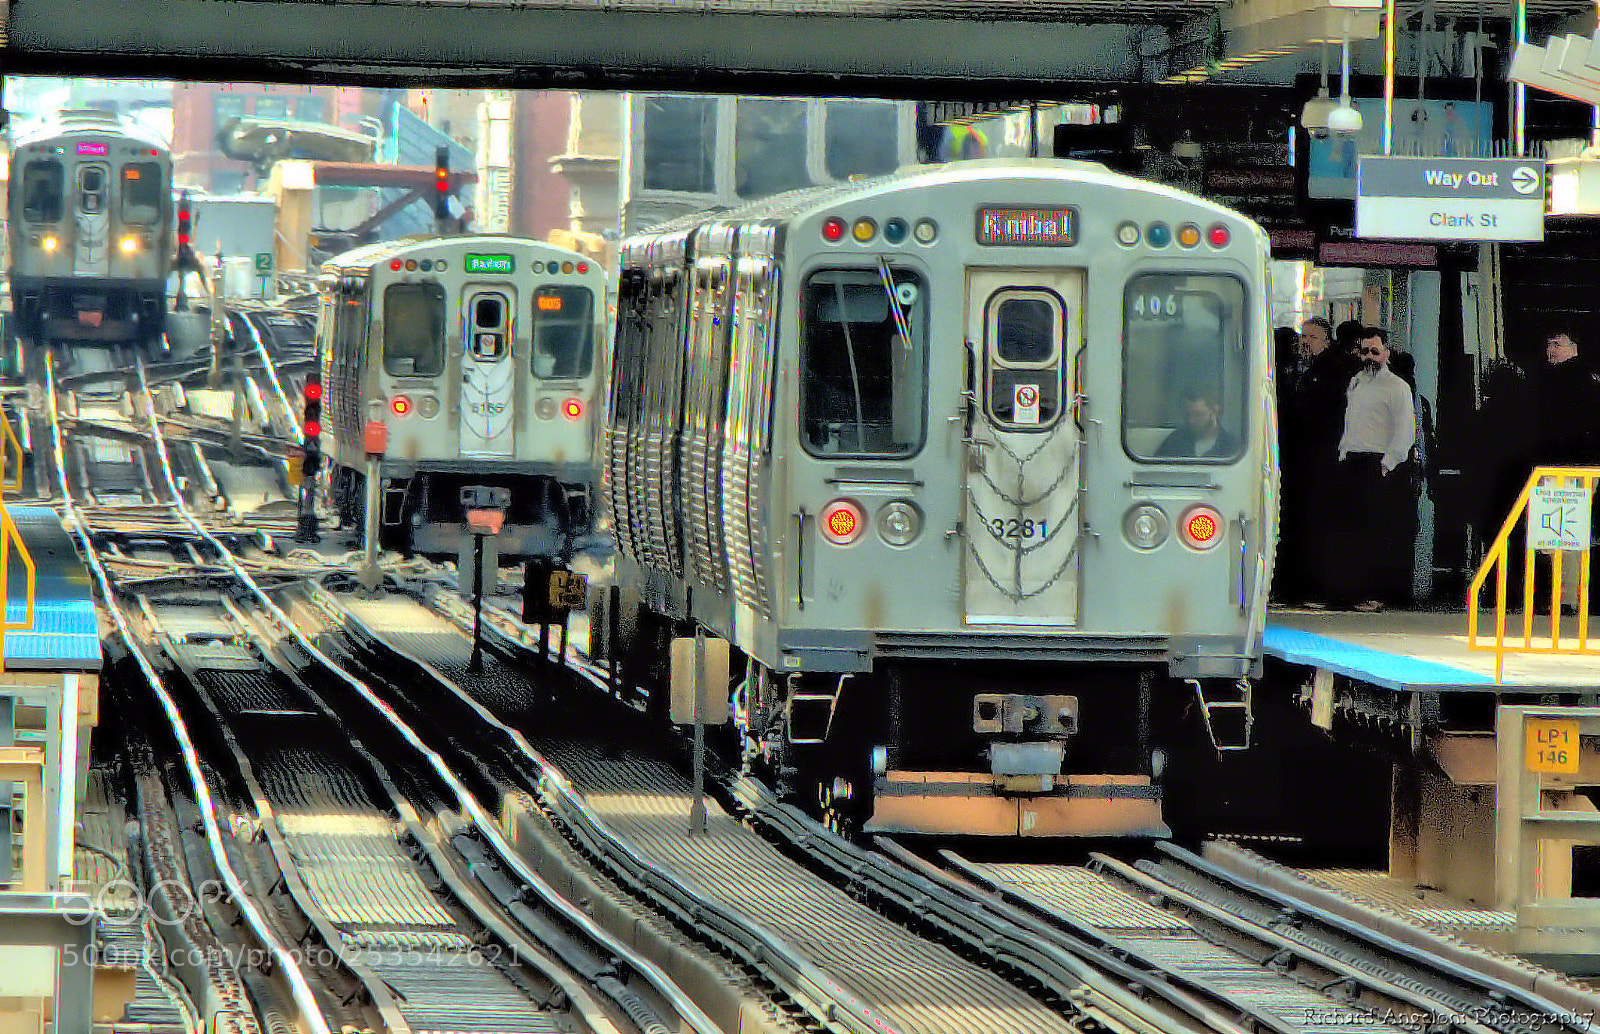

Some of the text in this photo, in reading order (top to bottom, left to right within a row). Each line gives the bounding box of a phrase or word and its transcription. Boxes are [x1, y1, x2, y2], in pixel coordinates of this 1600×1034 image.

[1425, 170, 1499, 189] Way Out
[984, 214, 1070, 236] Kmbal
[1428, 212, 1498, 228] Clark St
[259, 254, 270, 268] 2
[1134, 294, 1177, 316] 406
[991, 518, 1047, 538] 3281
[1537, 728, 1568, 743] LP1
[1537, 750, 1568, 764] 146
